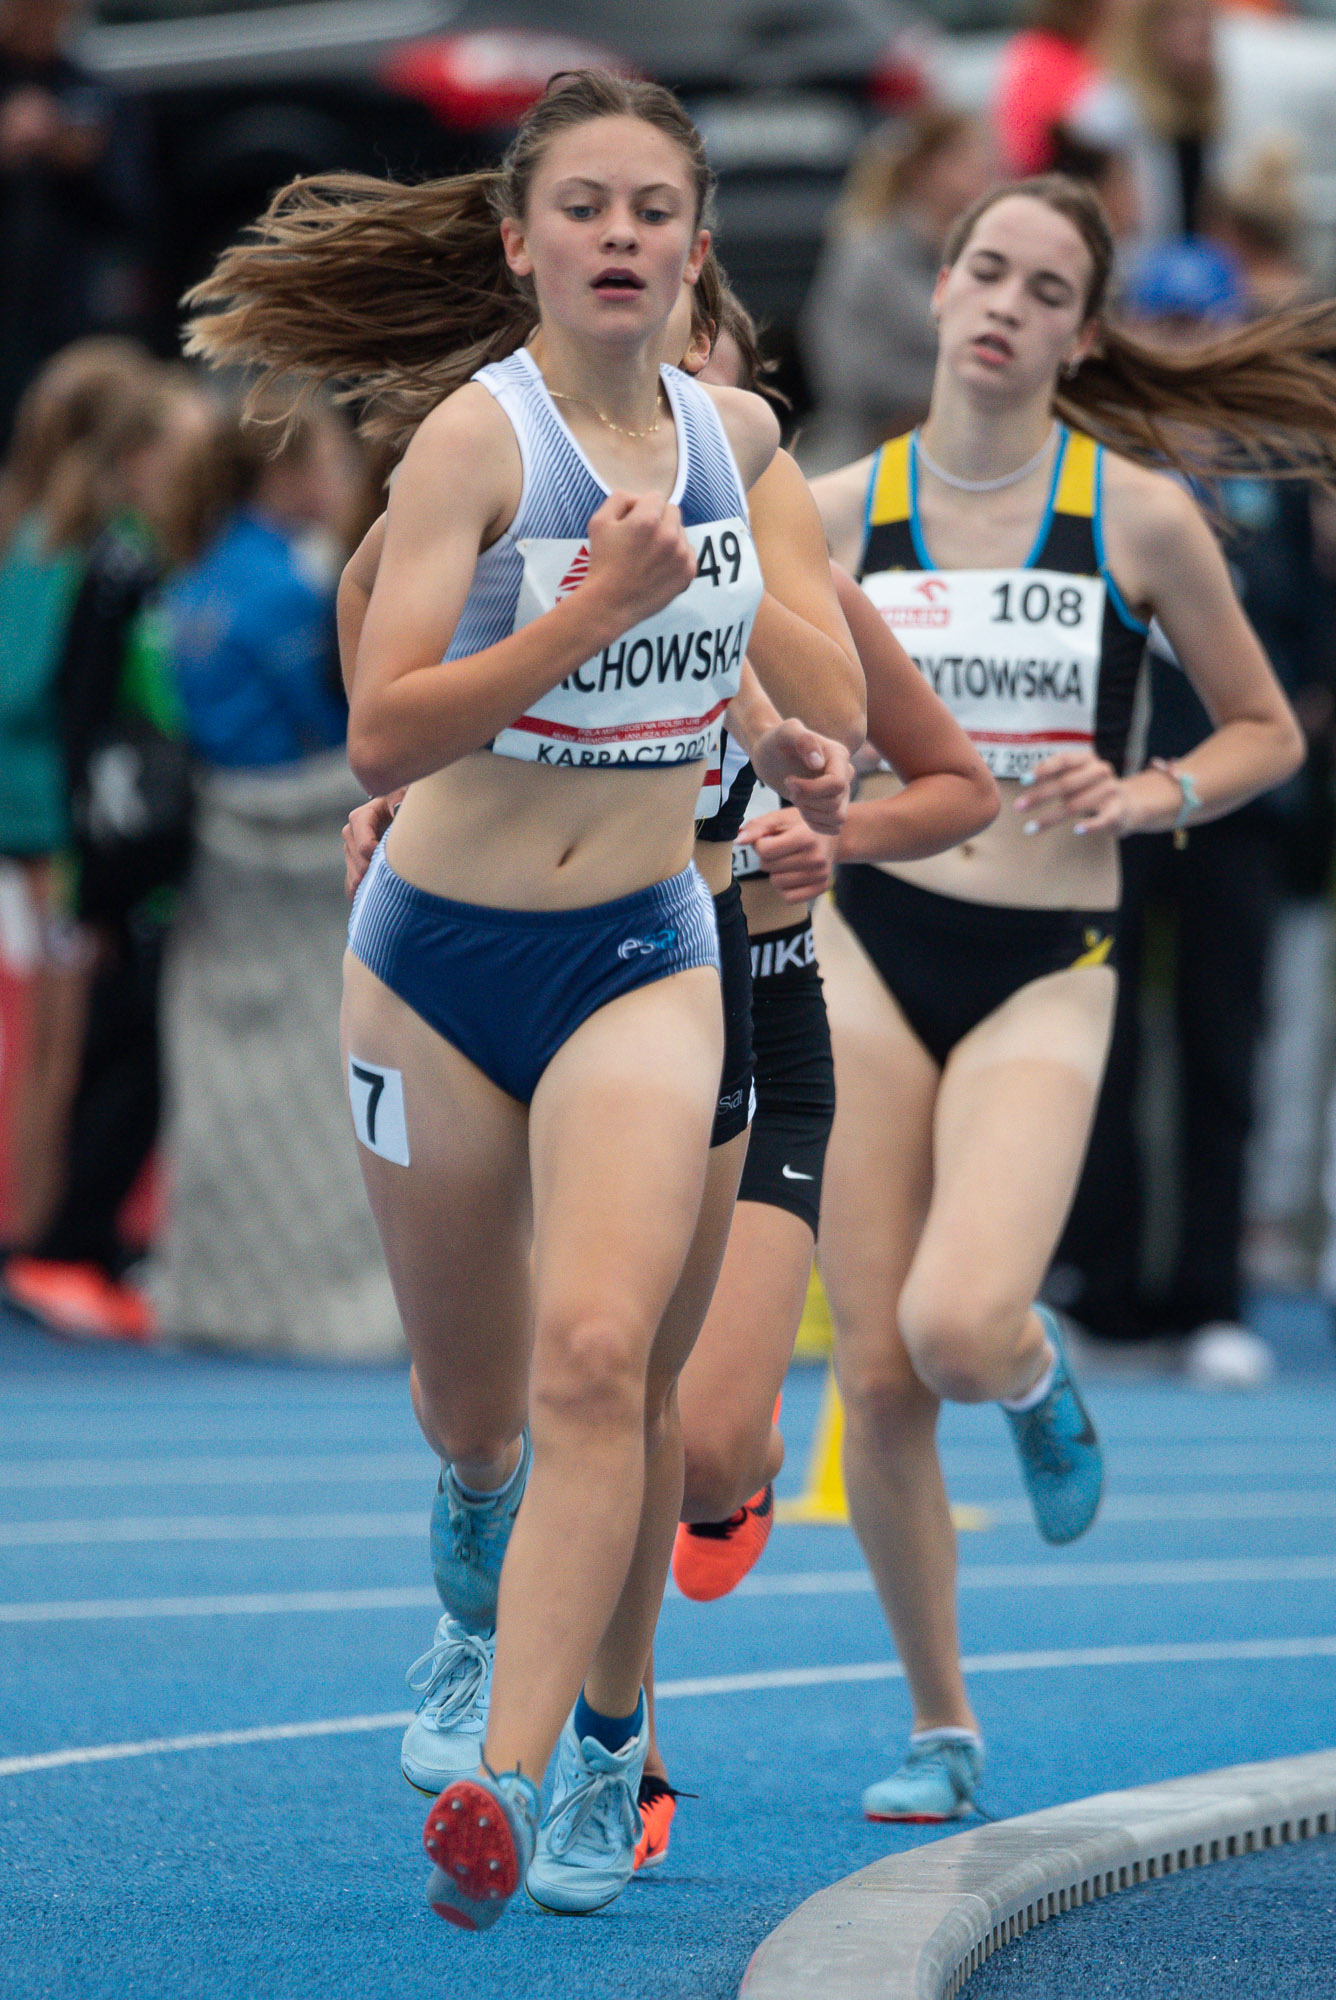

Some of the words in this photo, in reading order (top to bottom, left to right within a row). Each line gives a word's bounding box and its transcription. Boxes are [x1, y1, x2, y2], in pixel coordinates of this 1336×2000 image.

[992, 580, 1083, 627] 108
[561, 621, 744, 693] CHOWSKA
[351, 1063, 385, 1146] 7
